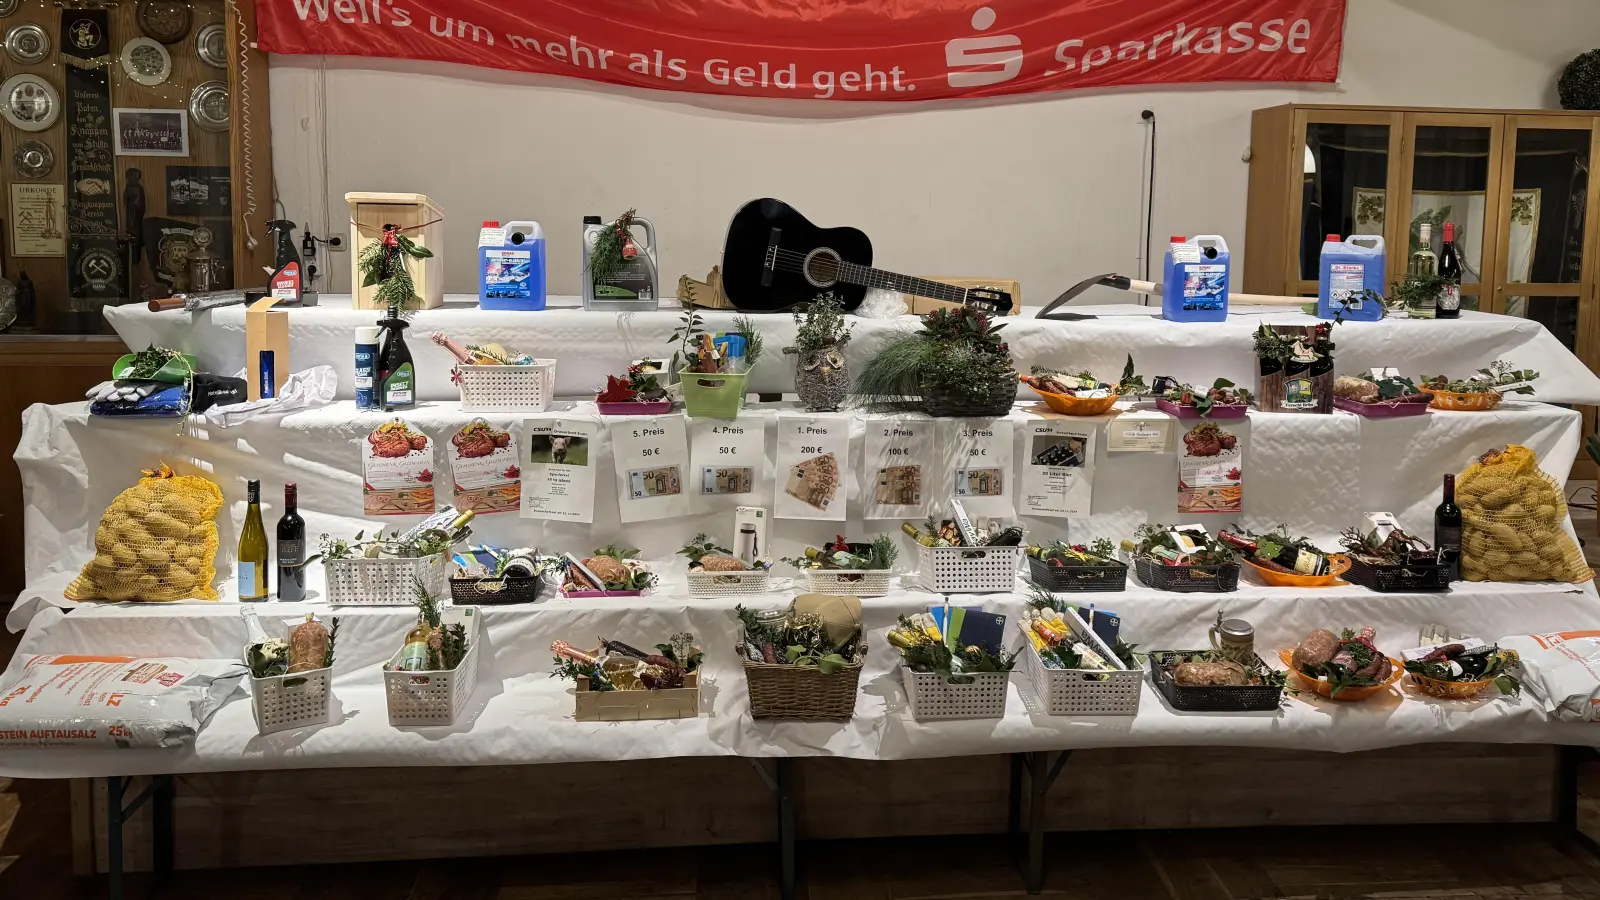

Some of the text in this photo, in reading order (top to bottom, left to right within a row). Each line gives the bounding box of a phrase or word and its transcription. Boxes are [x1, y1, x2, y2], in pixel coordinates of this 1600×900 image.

[1043, 18, 1311, 76] Sparkasse
[429, 15, 494, 45] um
[505, 34, 614, 69] mehr
[627, 48, 687, 81] als
[703, 58, 796, 89] Geld
[812, 63, 916, 99] geht.
[643, 427, 665, 436] Preis
[712, 426, 744, 435] 4. Preis
[797, 426, 828, 435] 1. Preis
[893, 429, 913, 437] Preis
[963, 429, 993, 437] 3. Preis
[642, 447, 660, 456] 50 €
[719, 446, 737, 454] 50 €
[801, 446, 823, 454] 200 €
[903, 447, 909, 455] €
[969, 448, 987, 456] 50 €
[642, 470, 654, 480] 50
[715, 469, 728, 478] 50
[967, 470, 979, 479] 50
[29, 729, 97, 739] AUFTAUSALZ
[108, 725, 124, 736] 25
[124, 729, 133, 738] kg
